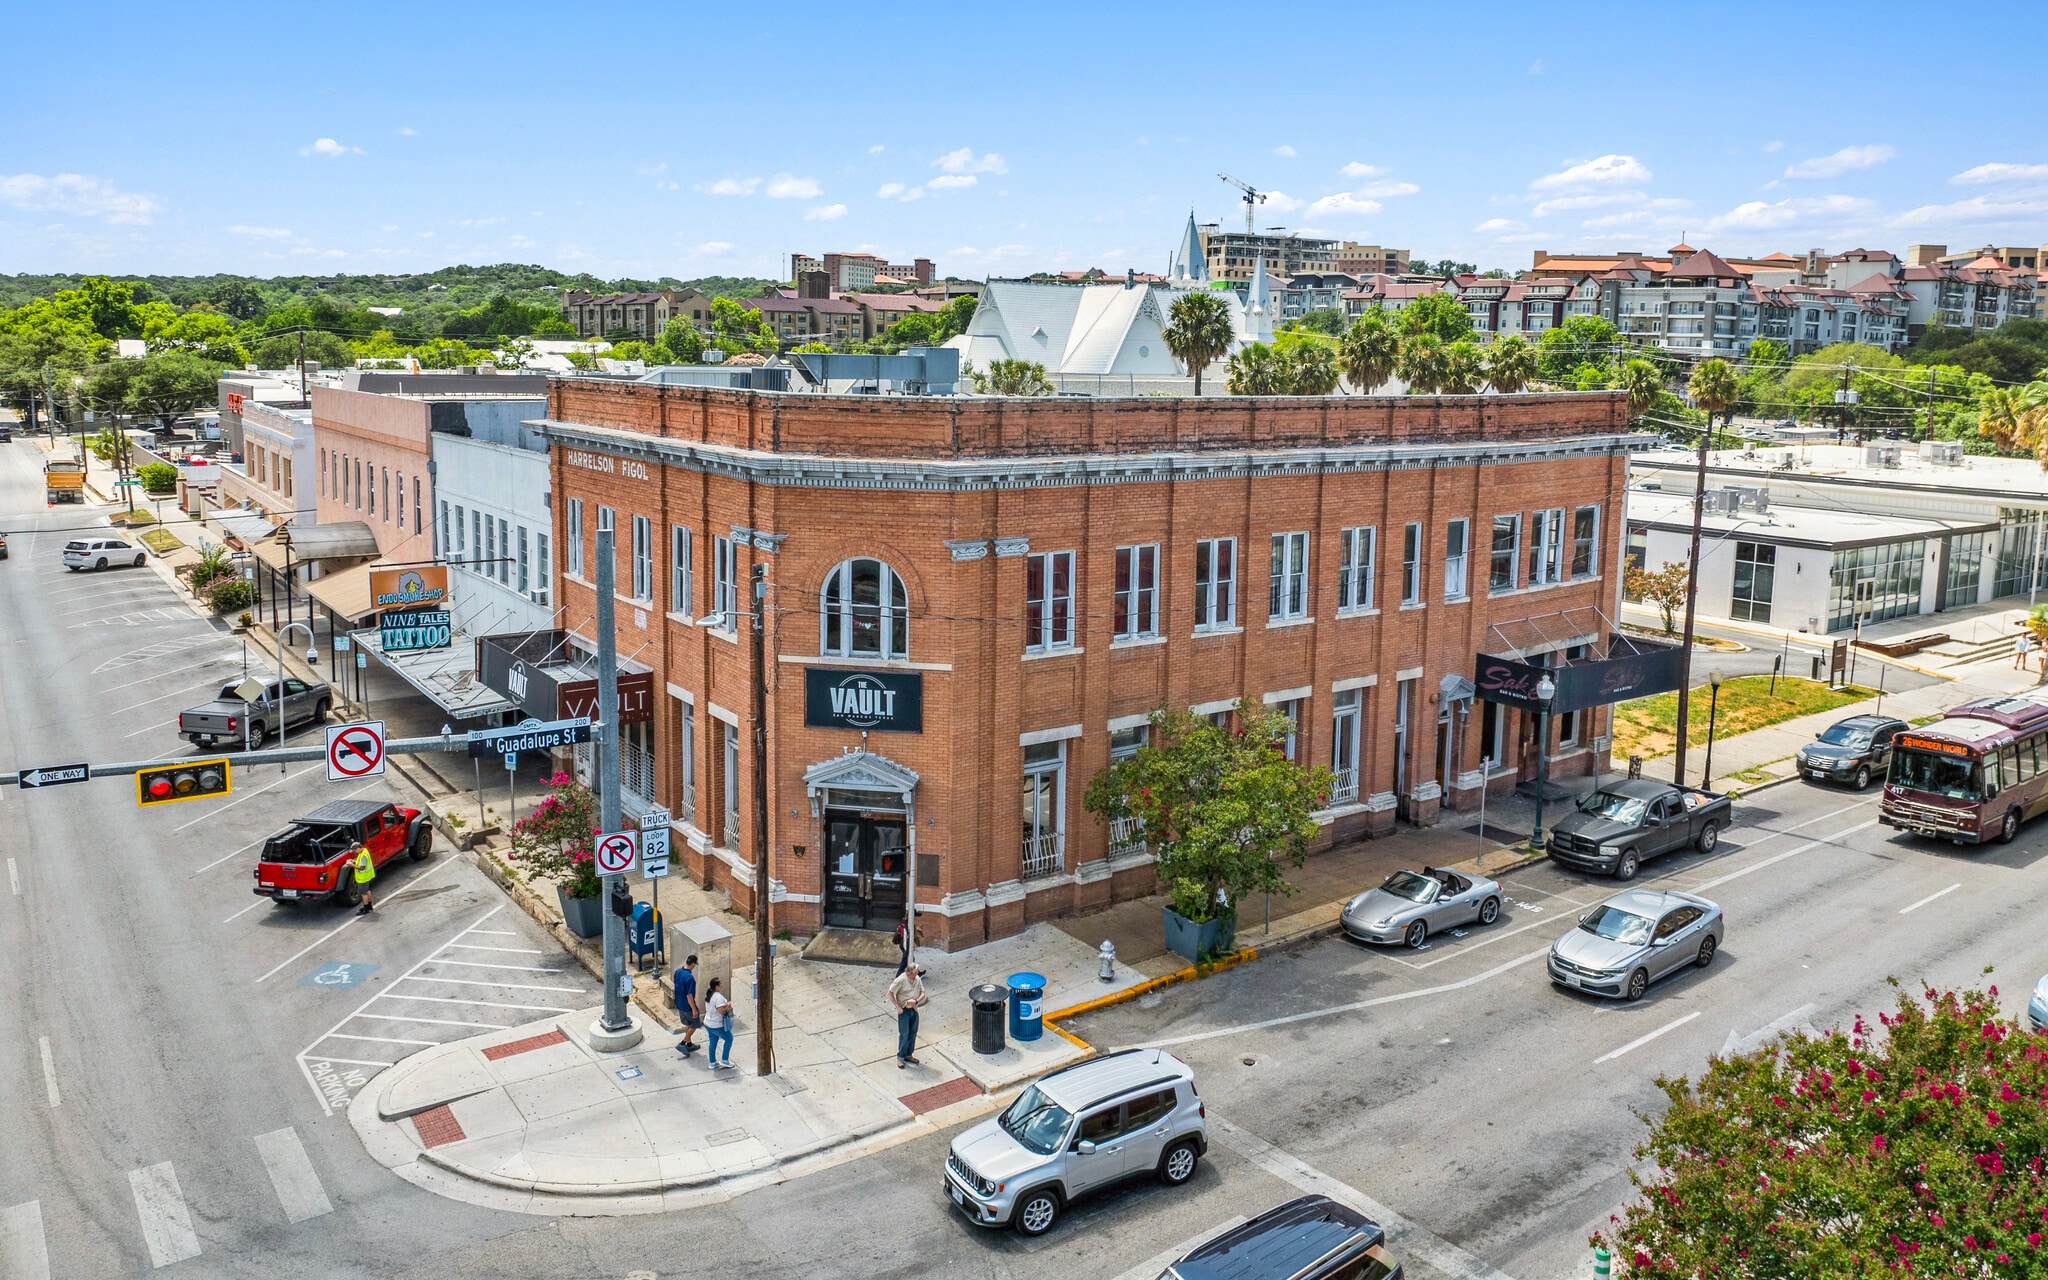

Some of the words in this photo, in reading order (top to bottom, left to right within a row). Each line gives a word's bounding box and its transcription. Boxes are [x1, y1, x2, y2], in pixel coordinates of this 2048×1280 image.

[568, 450, 614, 473] HARRELSON
[622, 460, 649, 480] FIGOL
[377, 594, 398, 605] ENDO
[398, 592, 424, 603] SMOKE
[425, 588, 443, 600] SHOP
[383, 613, 416, 628] NINE
[418, 613, 449, 624] TALES
[382, 625, 450, 650] TATTOO
[508, 667, 528, 699] VAULT
[858, 681, 867, 689] THE
[565, 690, 647, 718] VALT
[830, 687, 896, 716] VAULT
[471, 732, 483, 740] 100
[574, 718, 587, 726] 200
[486, 739, 492, 748] N
[497, 732, 559, 753] Guadalupe
[563, 728, 576, 744] St
[1902, 736, 1912, 746] 26
[1912, 738, 1942, 751] WONDER
[1943, 743, 1968, 756] WORLD
[40, 772, 60, 781] ONE
[62, 769, 82, 778] WAY
[1891, 786, 1904, 795] 417
[643, 814, 668, 826] TRUCK
[647, 832, 664, 840] LOOP
[647, 841, 665, 855] 82
[310, 1061, 352, 1107] PARKING
[340, 1069, 367, 1087] NO
